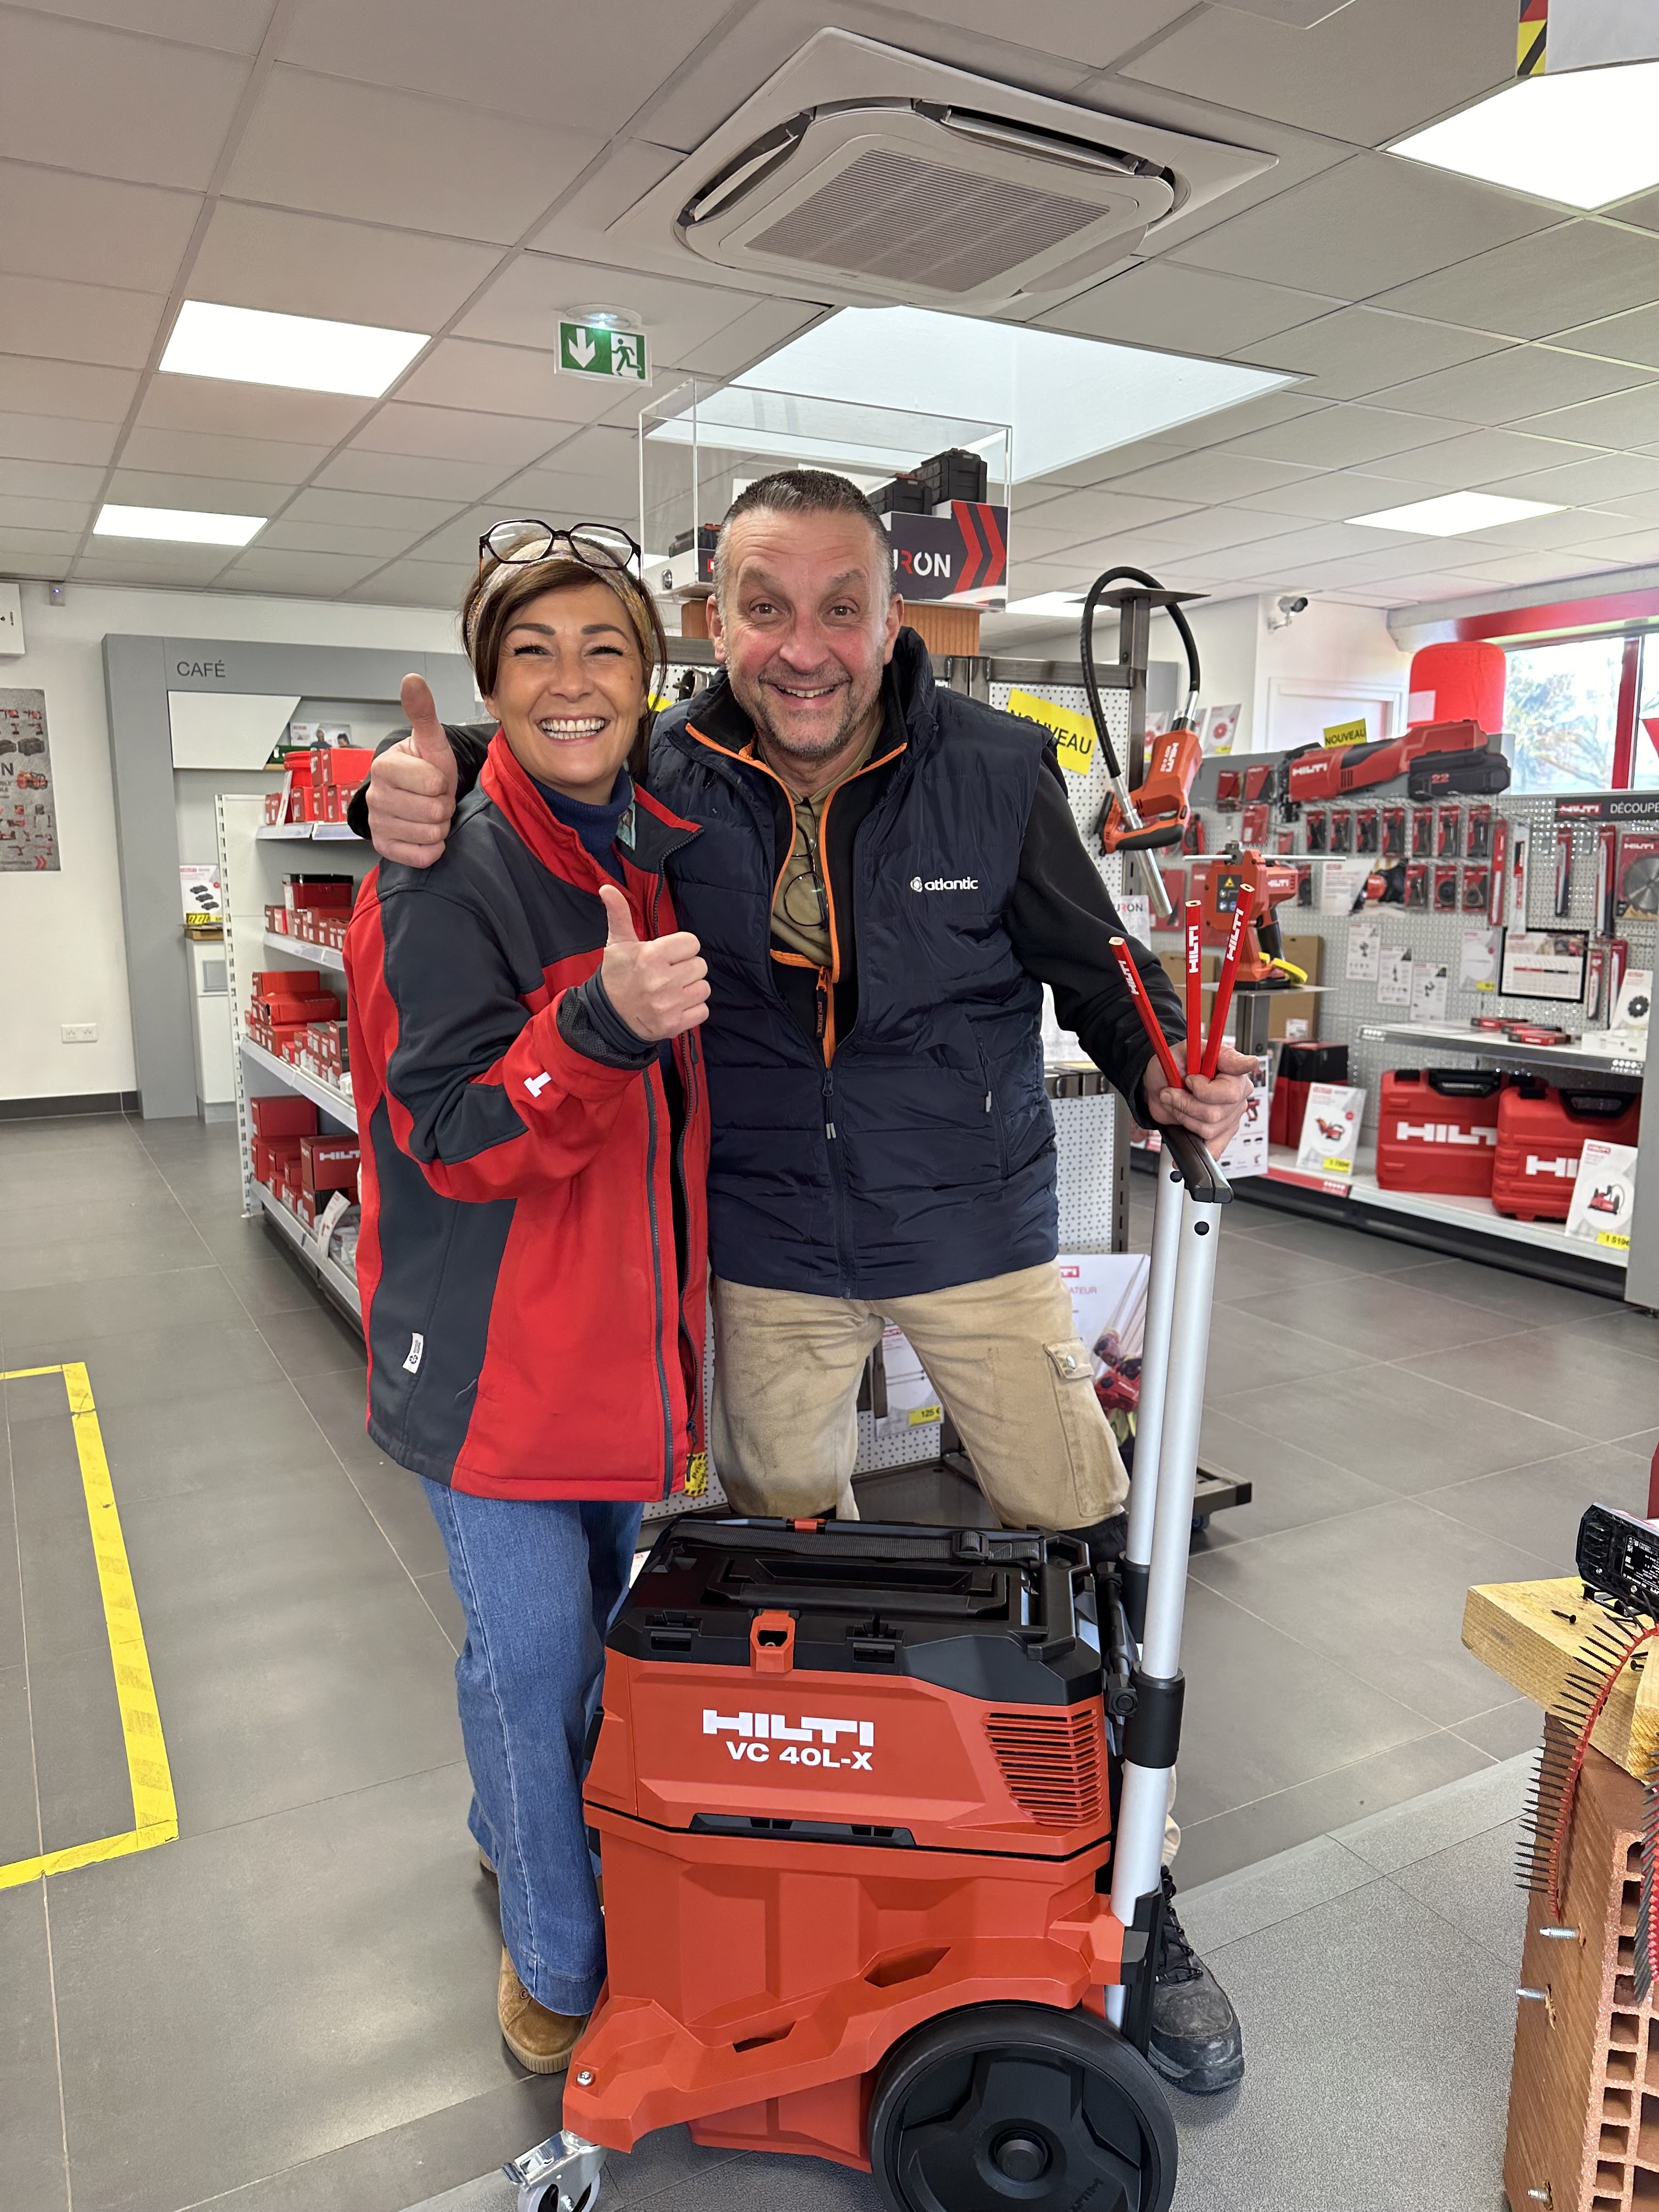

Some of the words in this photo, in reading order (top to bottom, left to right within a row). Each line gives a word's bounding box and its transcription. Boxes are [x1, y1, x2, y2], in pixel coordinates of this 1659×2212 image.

[893, 549, 951, 578] RON
[177, 660, 225, 678] CAFÉ
[1011, 709, 1092, 754] VEAU
[1325, 728, 1366, 744] NOUVEAU
[1165, 742, 1180, 772] HILTI
[1291, 762, 1328, 776] HILTI
[1431, 773, 1449, 784] 22
[924, 876, 978, 891] atlantic
[1226, 908, 1244, 961] HILTI
[1188, 926, 1199, 973] HILTI
[1118, 960, 1139, 995] HILTI
[1397, 1121, 1498, 1146] HILT
[319, 1150, 361, 1161] HILT
[703, 1709, 874, 1747] HILTI
[726, 1741, 769, 1762] VC
[779, 1746, 873, 1771] 40L-X
